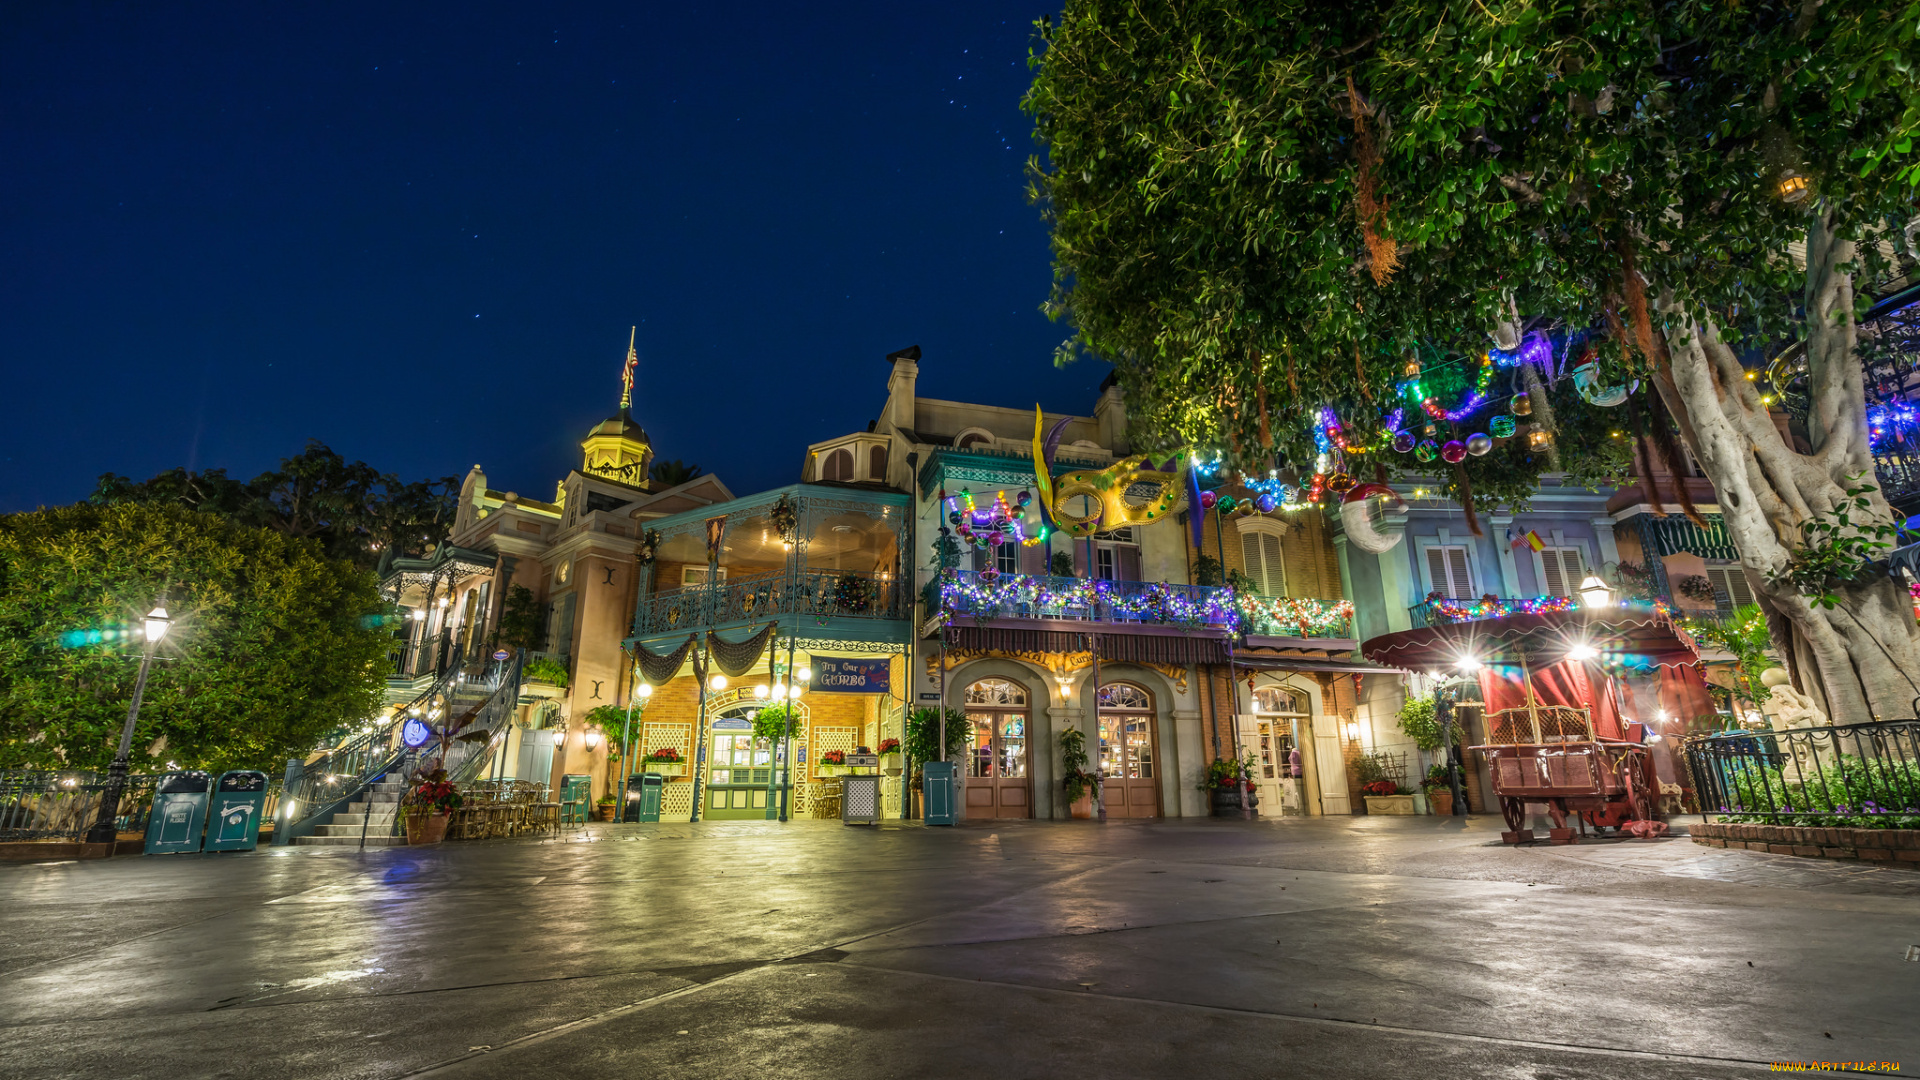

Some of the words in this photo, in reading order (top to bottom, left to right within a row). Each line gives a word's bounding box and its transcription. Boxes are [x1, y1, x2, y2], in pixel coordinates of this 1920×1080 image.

[821, 661, 837, 672] Try
[842, 662, 858, 672] Our
[820, 673, 866, 686] GUMBO
